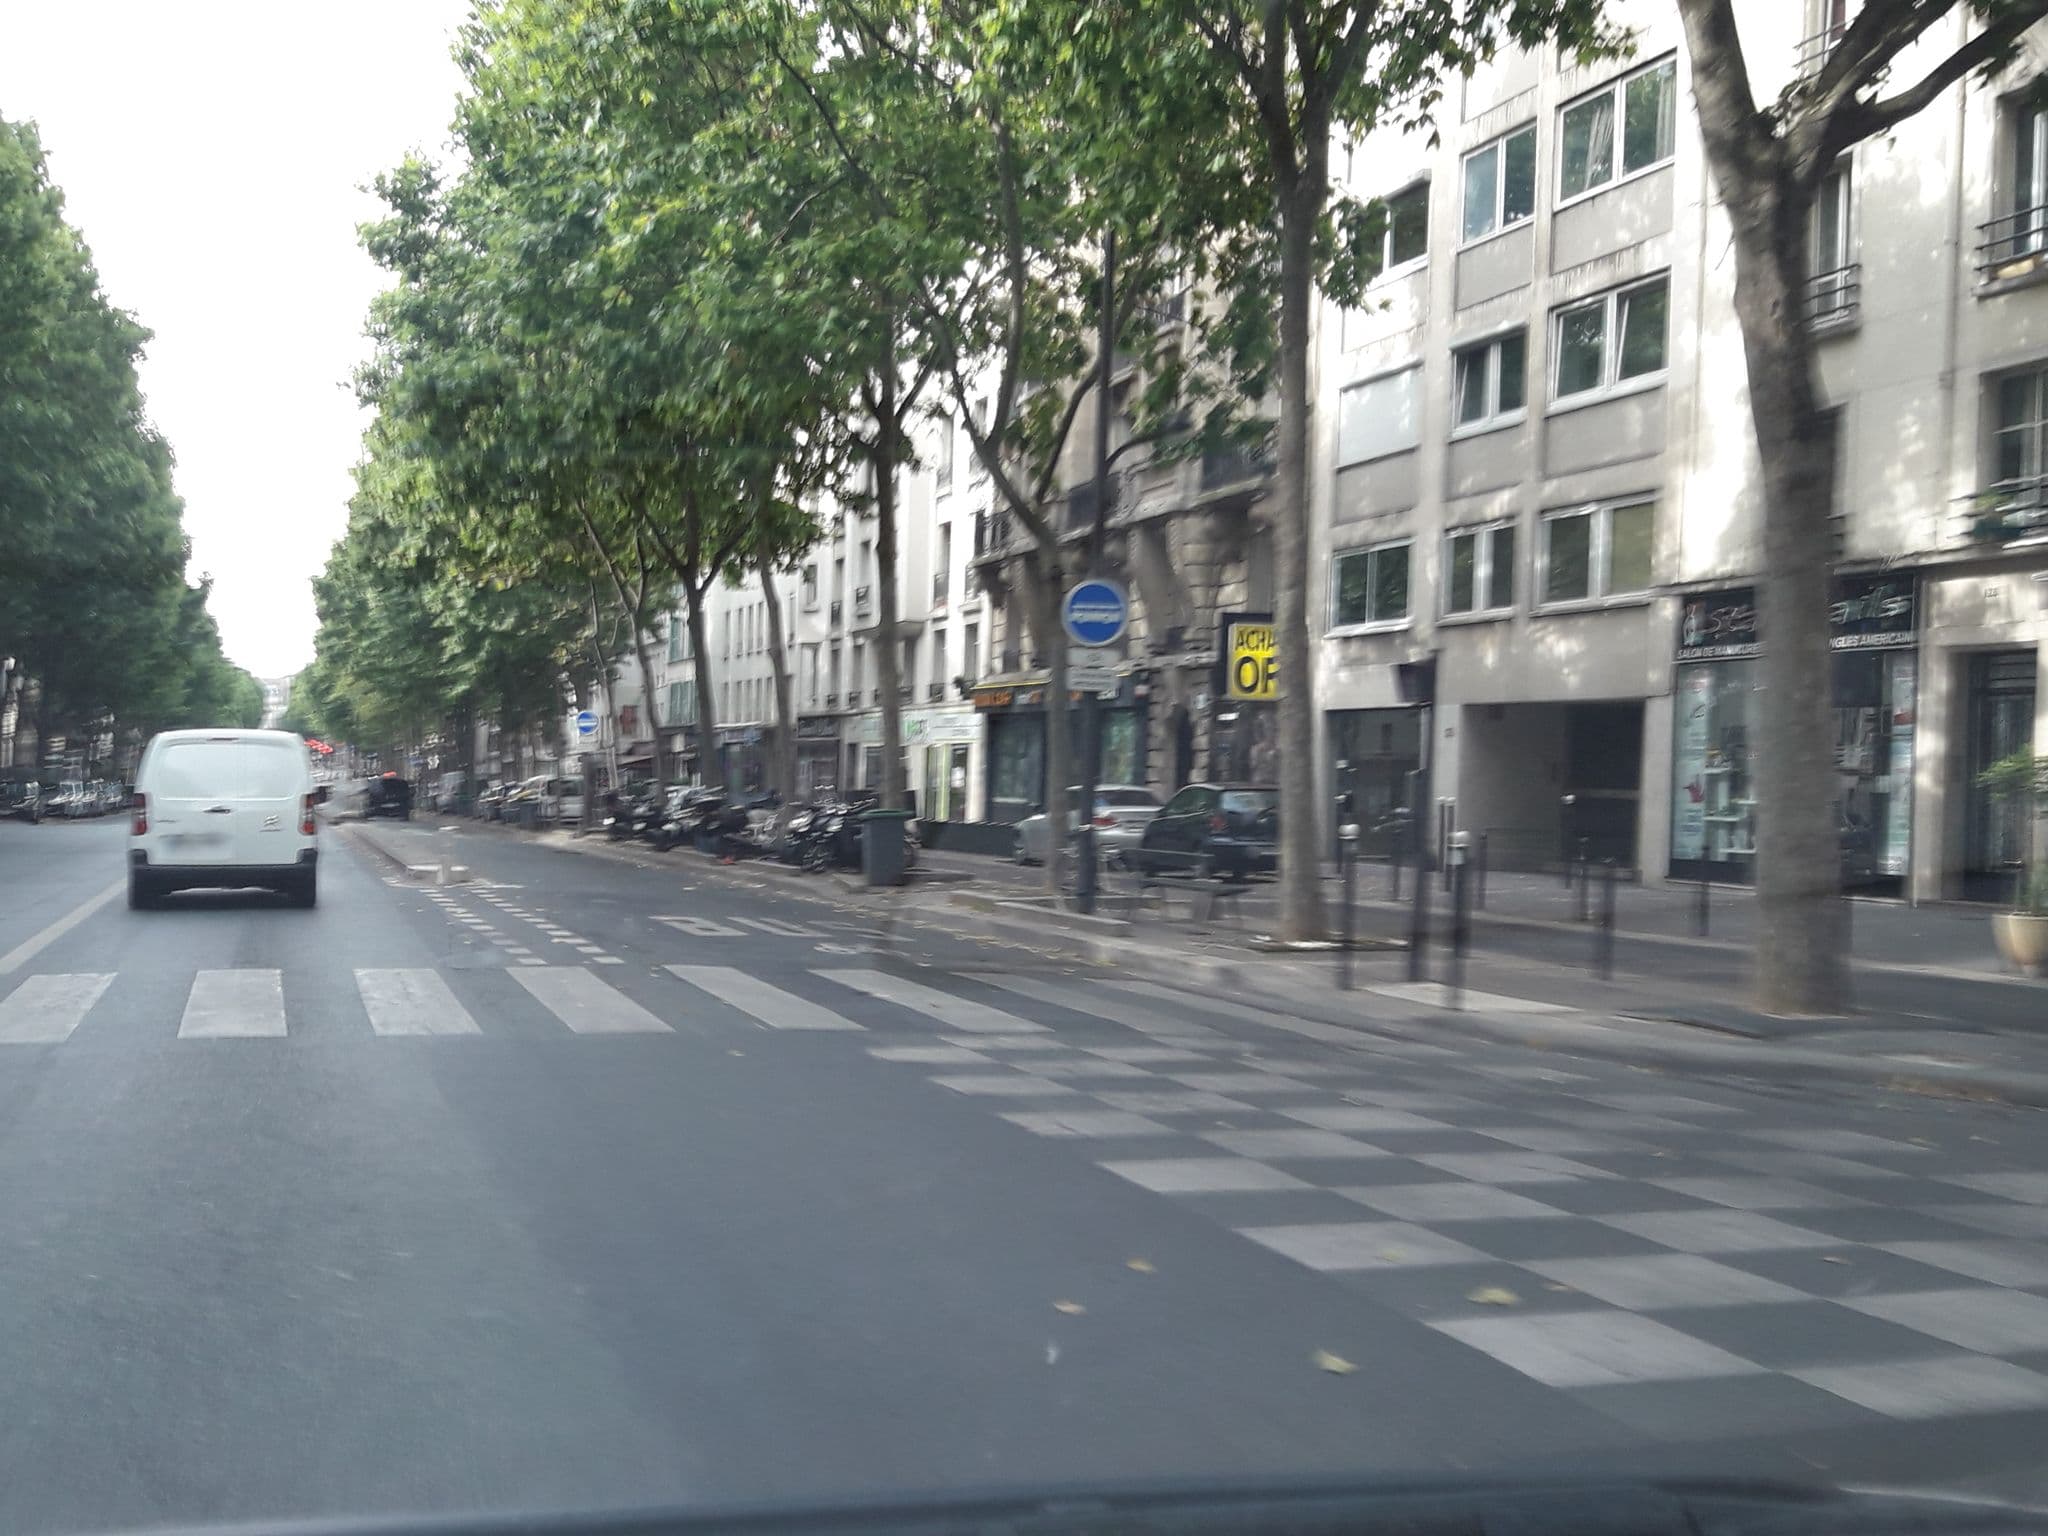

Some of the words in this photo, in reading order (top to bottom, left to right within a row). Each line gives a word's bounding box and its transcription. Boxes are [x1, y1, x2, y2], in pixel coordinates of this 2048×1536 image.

[1829, 585, 1913, 624] ails
[1829, 634, 1858, 648] NGLES
[648, 915, 916, 942] BUS
